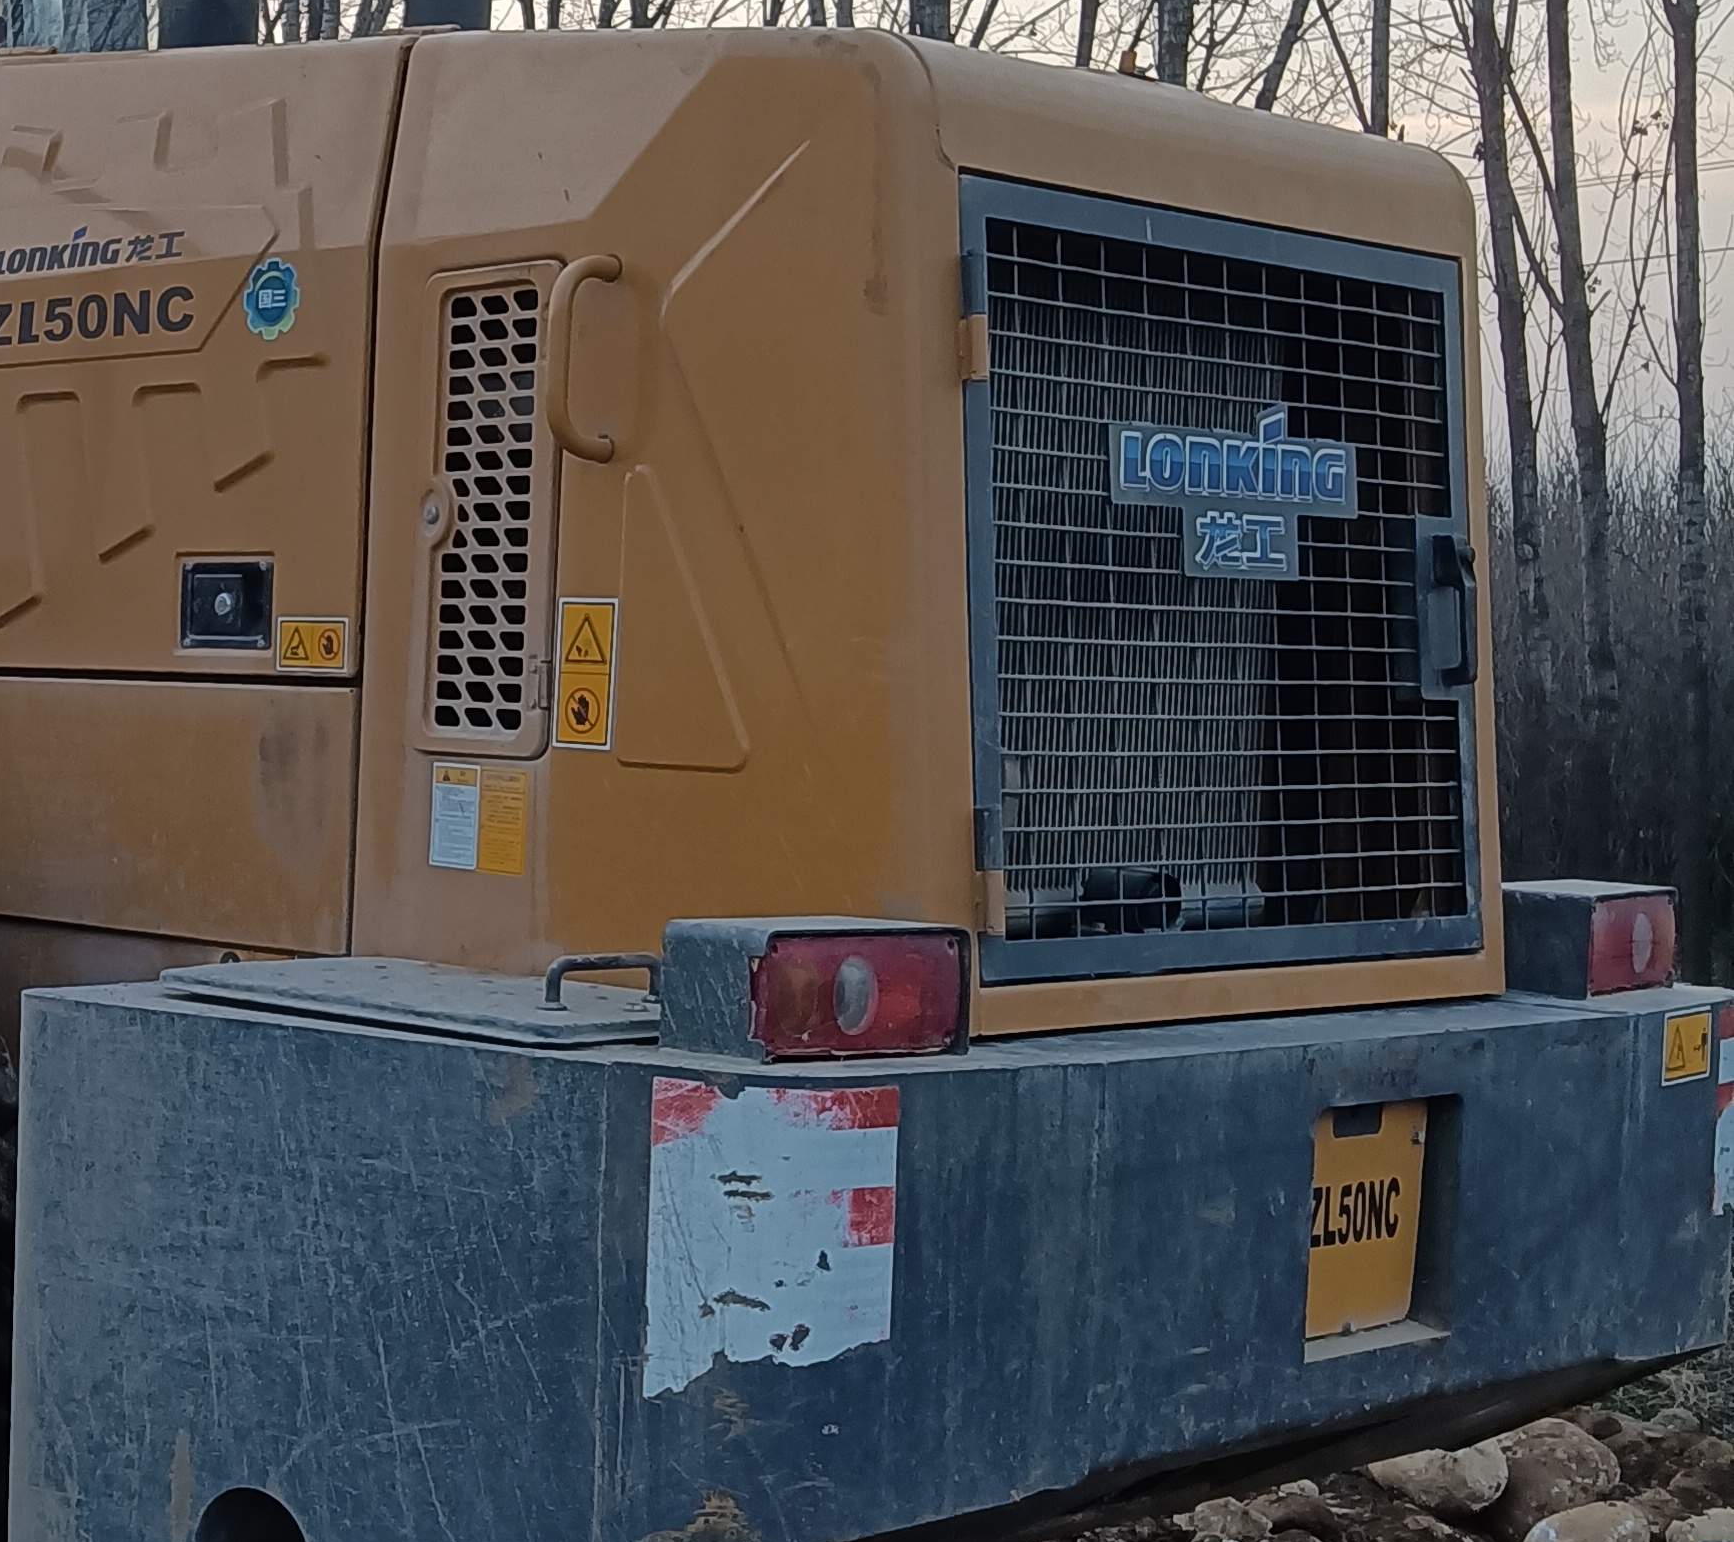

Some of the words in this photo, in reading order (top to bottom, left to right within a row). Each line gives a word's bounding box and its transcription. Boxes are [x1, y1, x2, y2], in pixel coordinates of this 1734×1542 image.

[125, 231, 186, 263] 龙工
[1195, 511, 1288, 571] 龙工
[1309, 1177, 1401, 1248] ZL50NC
